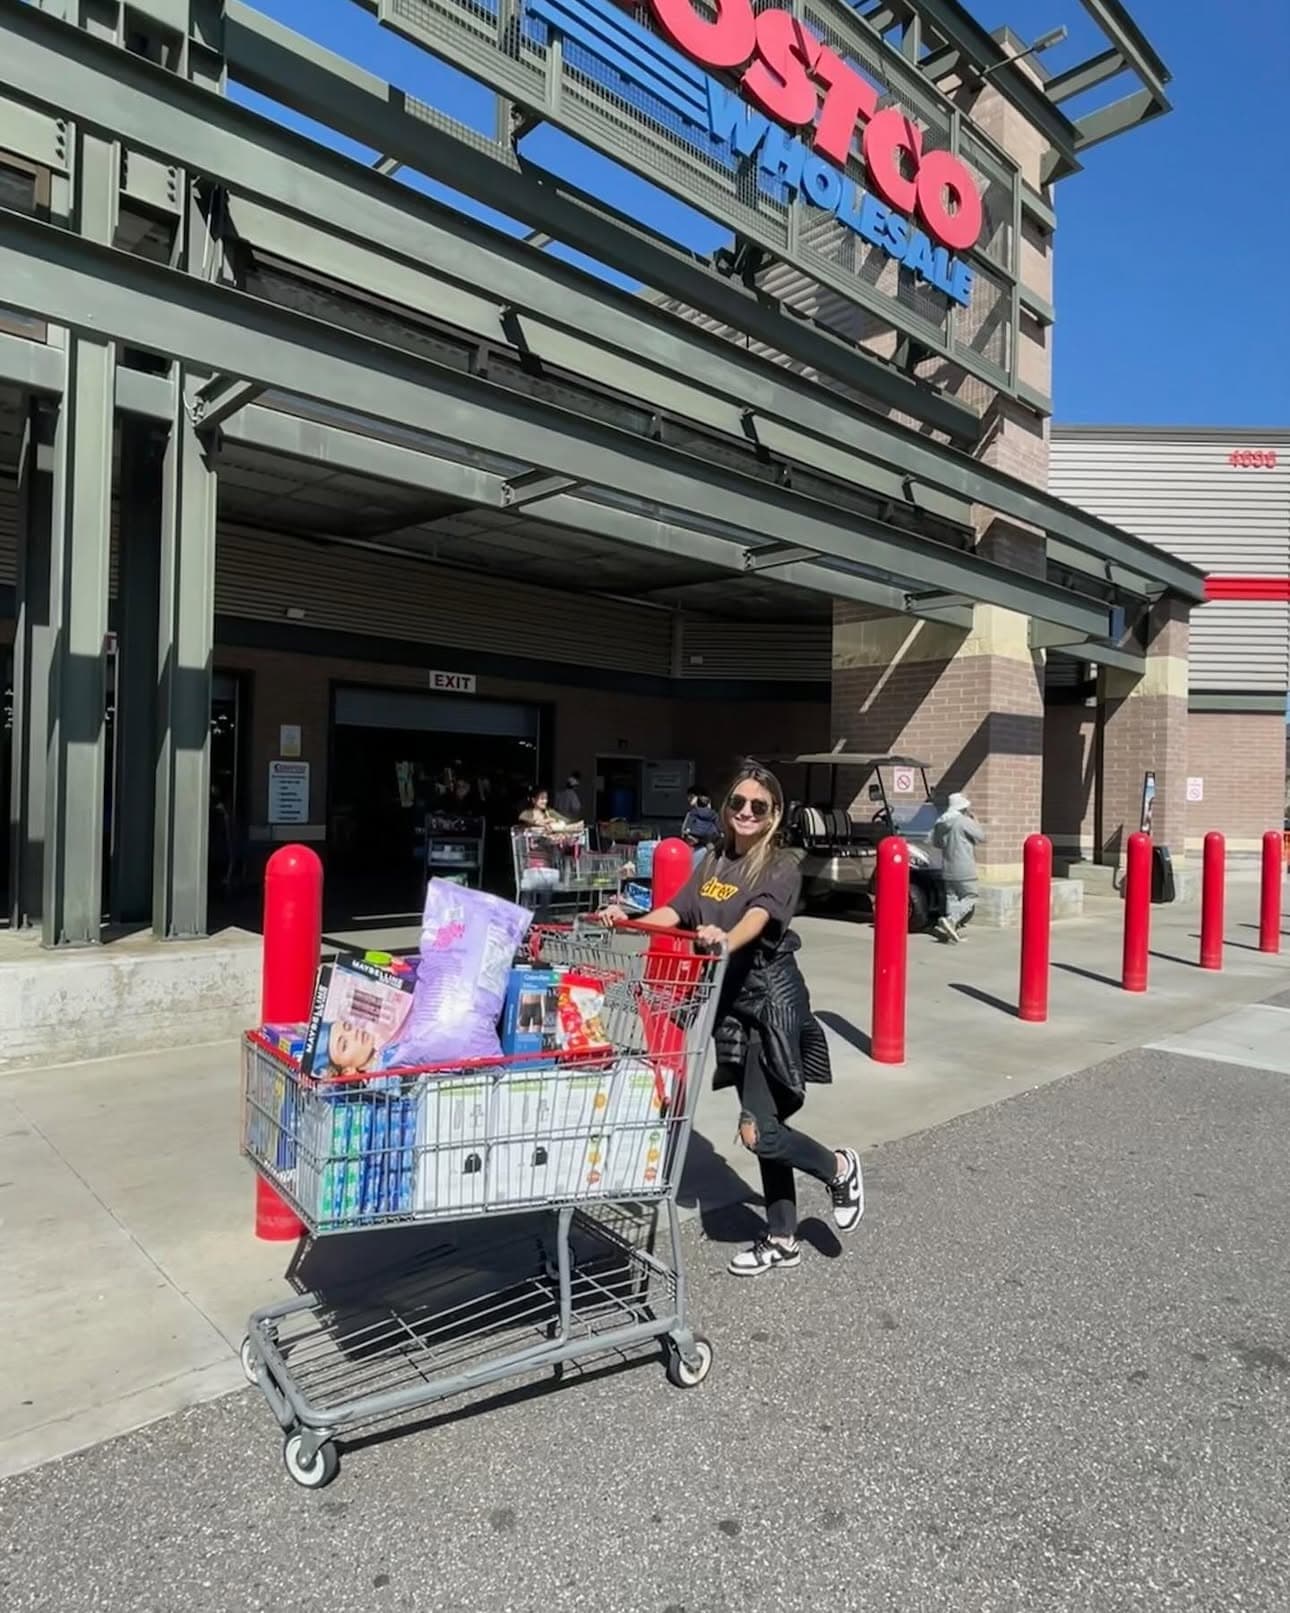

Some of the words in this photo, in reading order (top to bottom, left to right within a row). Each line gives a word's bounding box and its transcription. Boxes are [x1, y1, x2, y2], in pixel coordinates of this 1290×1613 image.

[650, 0, 983, 250] OSTCO
[705, 75, 974, 308] WHOLESALE
[434, 674, 472, 690] EXIT
[701, 876, 738, 901] drew
[351, 959, 404, 988] MAYBELLINE
[305, 984, 328, 1054] MAYBELLINE
